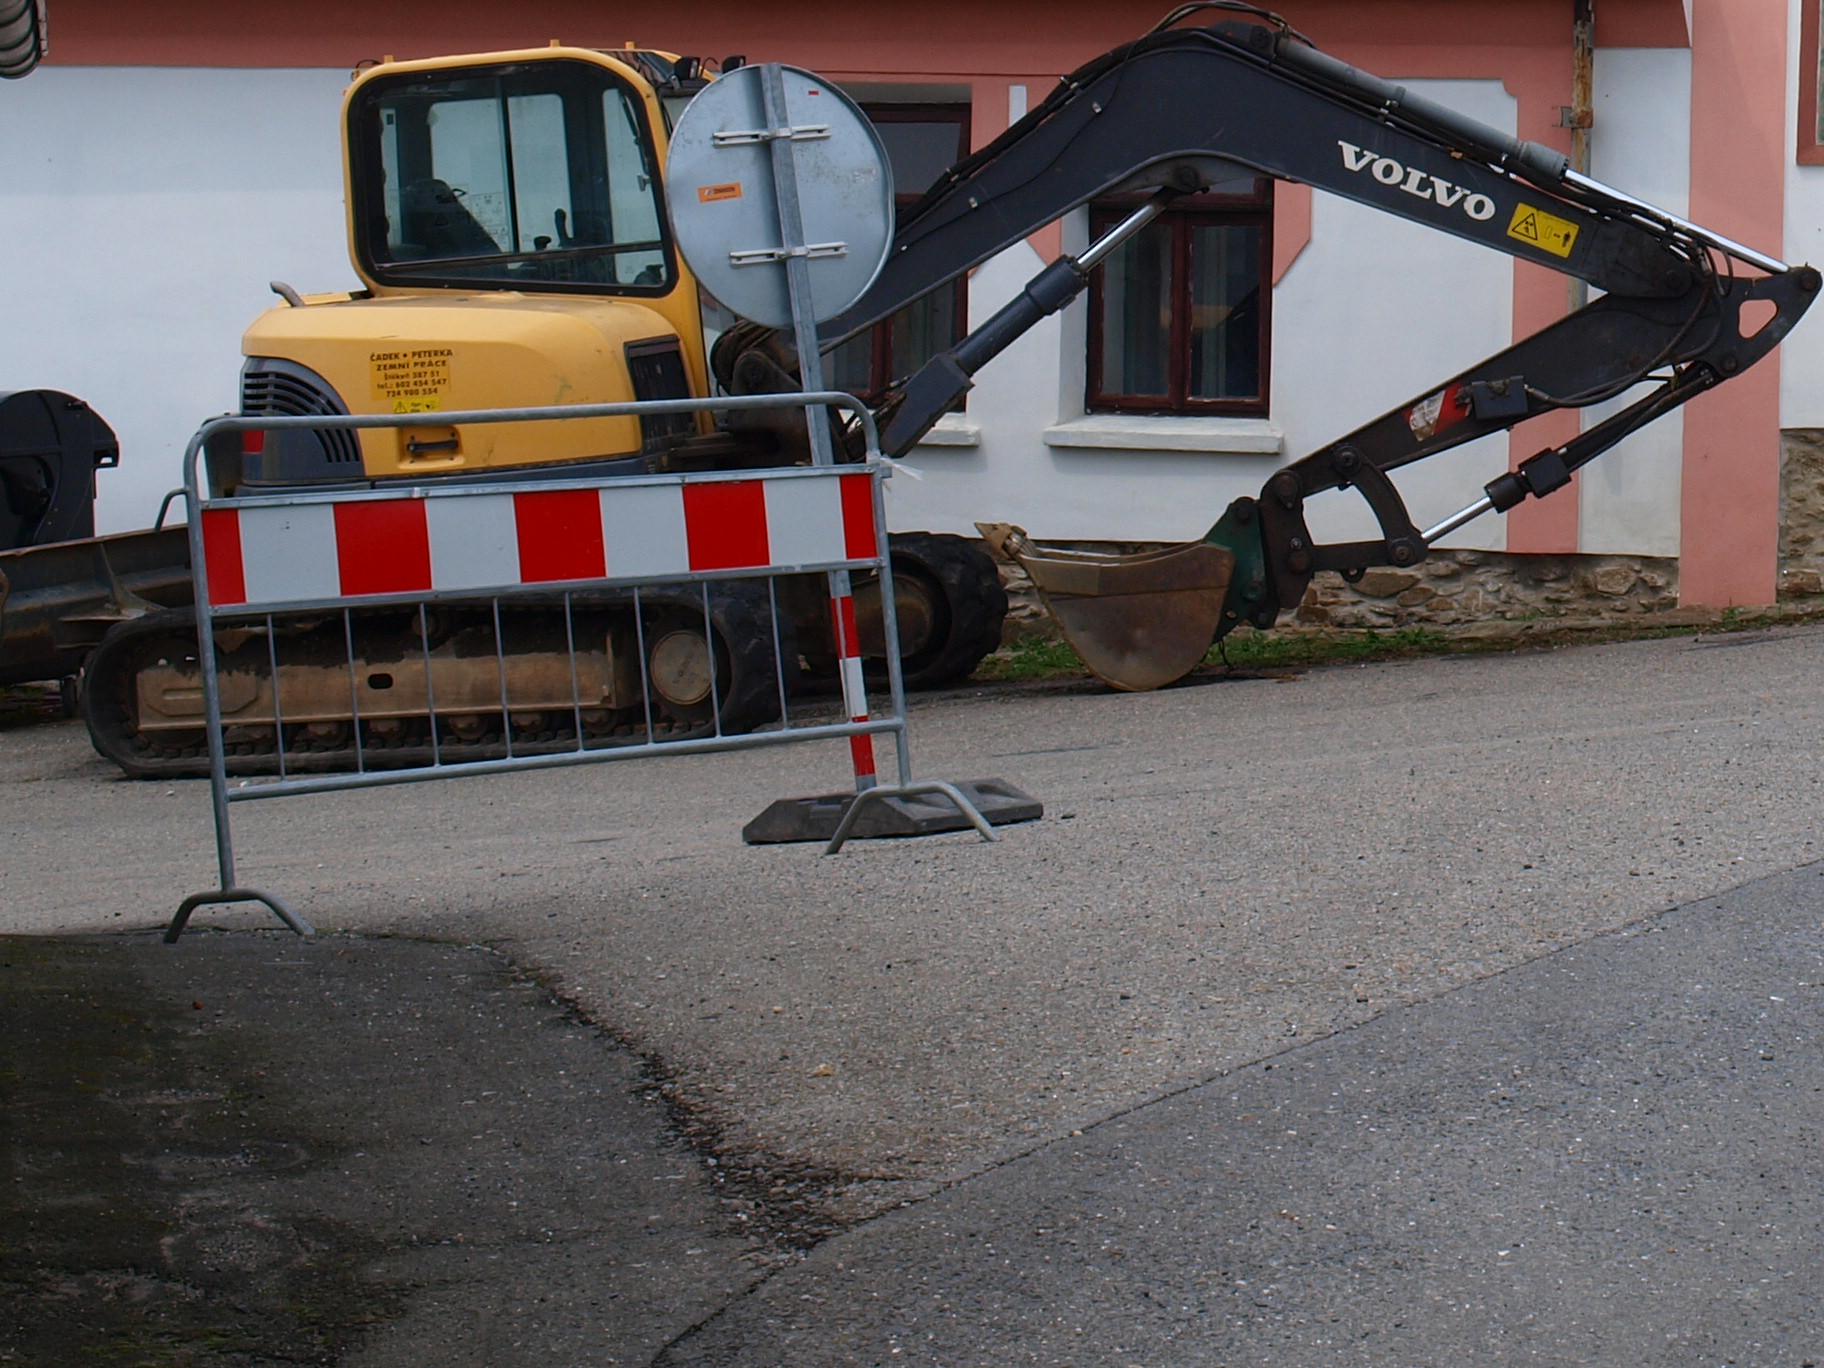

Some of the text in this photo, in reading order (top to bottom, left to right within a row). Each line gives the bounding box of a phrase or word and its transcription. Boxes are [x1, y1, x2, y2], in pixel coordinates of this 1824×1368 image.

[1337, 140, 1497, 222] VOLVO
[411, 349, 454, 360] PETERKA
[376, 360, 447, 372] ZEMNÍ PRÁCE
